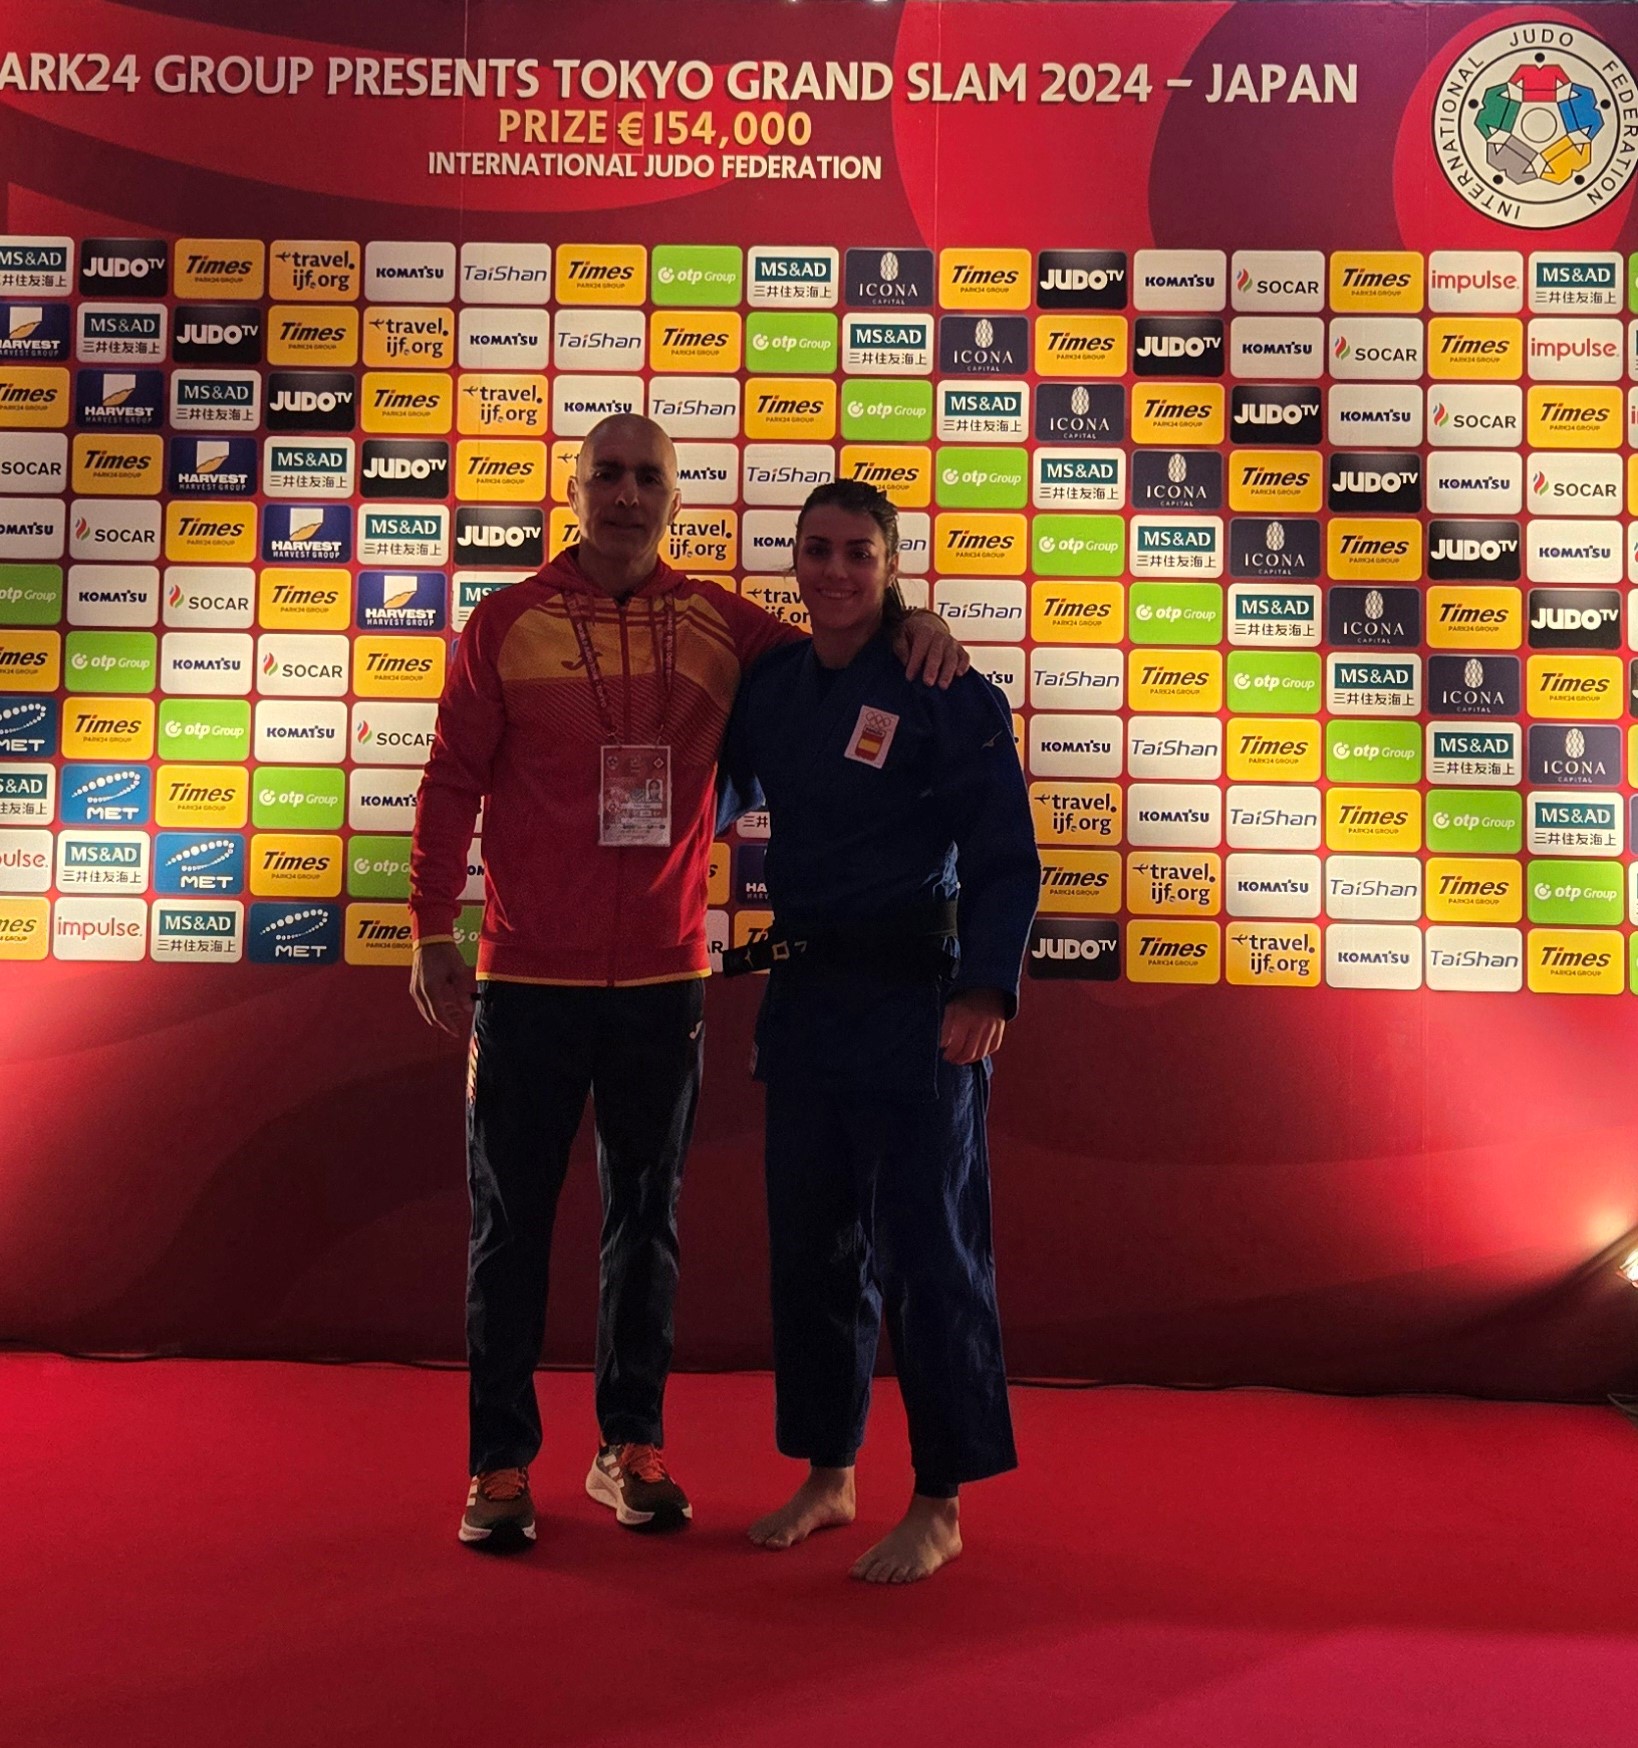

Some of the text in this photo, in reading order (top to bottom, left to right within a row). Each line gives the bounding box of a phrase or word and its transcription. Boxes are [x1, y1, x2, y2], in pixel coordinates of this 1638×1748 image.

[1509, 28, 1574, 47] JUDO
[0, 51, 140, 92] ARK24
[154, 54, 314, 94] GROUP
[327, 57, 539, 97] PRESENTS
[553, 59, 713, 100] TOKYO
[727, 60, 894, 100] GRAND
[907, 62, 1027, 102] SLAM
[1040, 62, 1153, 103] 2024
[1205, 63, 1357, 103] JAPAN
[498, 109, 608, 143] PRIZE
[1586, 60, 1638, 206] FEDERATION
[1439, 56, 1521, 220] INTERNATIONAL
[428, 152, 882, 180] INTERNATIONAL JUDO FEDERATION
[375, 265, 444, 279] KOMATSU
[463, 264, 548, 282] TaiShan
[568, 260, 635, 280] Times
[677, 268, 737, 286] otp Group
[760, 261, 827, 278] MS&AD
[1542, 267, 1611, 283] MS&AD
[859, 279, 918, 297] ICONA
[1145, 273, 1215, 288] KOMATSU
[1257, 280, 1319, 295] SOCAR
[753, 285, 832, 299] 三井住友海上
[1534, 291, 1617, 305] 三井住友海上
[872, 298, 906, 306] CAPITAL
[279, 321, 347, 342] Times
[469, 332, 538, 346] KOMATSU
[557, 332, 642, 349] TaiShan
[771, 335, 832, 353] otp Group
[1242, 341, 1313, 355] KOMATSU
[953, 346, 1013, 364] ICONA
[1354, 347, 1418, 362] SOCAR
[184, 384, 249, 400] MS&AD
[653, 400, 736, 416] TaiShan
[866, 402, 927, 420] otp Group
[950, 395, 1017, 412] MS&AD
[1144, 399, 1213, 419] Times
[84, 406, 154, 417] HARVEST
[175, 407, 254, 422] 三井住友海上
[1340, 408, 1411, 423] KOMATSU
[942, 419, 1022, 433] 三井住友海上
[1050, 417, 1110, 431] ICONA
[1453, 414, 1517, 429] SOCAR
[1063, 432, 1097, 440] CAPITAL
[1, 461, 62, 476] SOCAR
[178, 473, 248, 484] HARVEST
[1438, 475, 1510, 490] KOMATSU
[217, 484, 247, 492] GROUP
[1553, 482, 1617, 498] SOCAR
[371, 519, 437, 535] MS&AD
[94, 528, 156, 543] SOCAR
[946, 529, 1015, 550] Times
[271, 538, 342, 552] HARVEST
[363, 542, 442, 557] 三井住友海上
[1538, 544, 1611, 559] KOMATSU
[272, 551, 310, 559] HARVEST
[1244, 552, 1305, 567] ICONA
[78, 589, 148, 603] KOMATSU
[188, 596, 249, 611] SOCAR
[365, 606, 436, 619] HARVEST
[1155, 605, 1217, 623] otp Group
[1439, 603, 1509, 623] Times
[405, 619, 435, 627] GROUP
[90, 654, 151, 672] otp Group
[172, 657, 241, 671] KOMATSU
[281, 663, 343, 679] SOCAR
[1033, 669, 1120, 688] TaiShan
[1442, 690, 1505, 705] ICONA
[74, 713, 142, 734] Times
[184, 722, 245, 740] otp Group
[266, 724, 336, 739] KOMATSU
[1040, 739, 1111, 754] KOMATSU
[1131, 739, 1218, 757] TaiShan
[1439, 737, 1509, 754] MS&AD
[1432, 761, 1515, 776] 三井住友海上
[1544, 760, 1606, 776] ICONA
[278, 790, 339, 808] otp Group
[86, 806, 140, 820] MET
[1138, 808, 1210, 823] KOMATSU
[1230, 808, 1318, 827] TaiShan
[1453, 813, 1516, 831] otp Group
[70, 846, 137, 862] MS&AD
[263, 851, 331, 871] Times
[62, 869, 142, 884] 三井住友海上
[180, 875, 234, 889] MET
[1237, 879, 1309, 894] KOMATSU
[1330, 879, 1418, 897] TaiShan
[164, 914, 231, 931] MS&AD
[157, 939, 237, 953] 三井住友海上
[274, 944, 328, 958] MET
[1337, 950, 1410, 965] KOMATSU
[1430, 950, 1519, 968] TaiShan
[1541, 946, 1612, 968] Times
